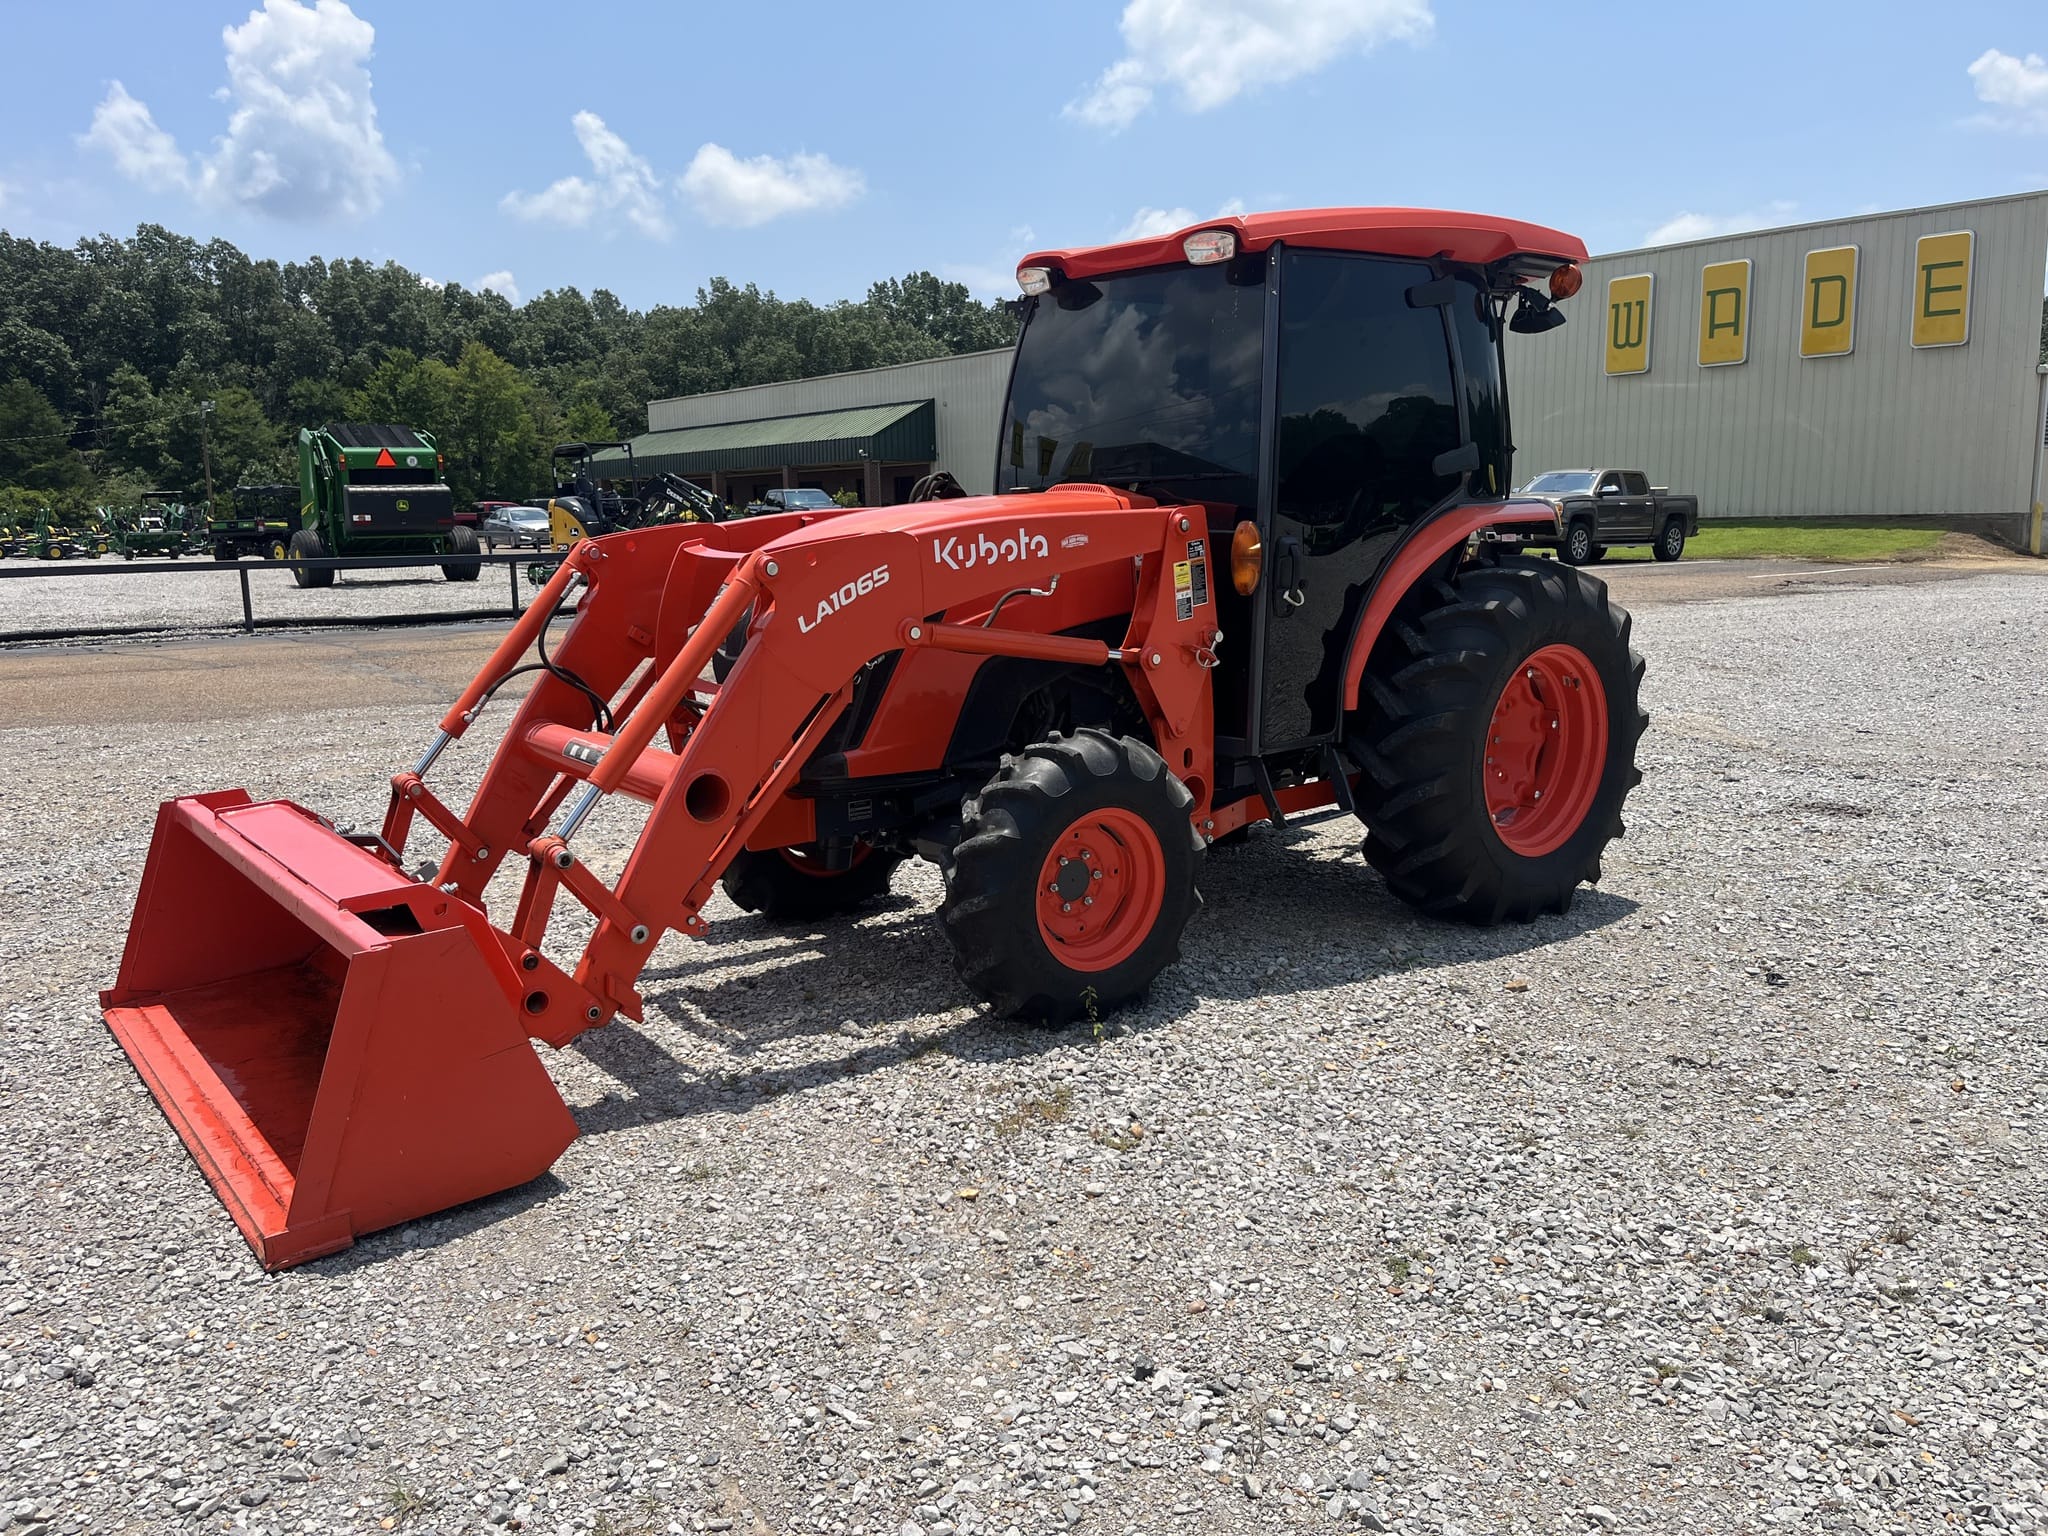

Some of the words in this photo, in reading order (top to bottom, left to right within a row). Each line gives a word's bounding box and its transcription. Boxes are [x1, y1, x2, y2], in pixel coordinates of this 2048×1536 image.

[1611, 260, 1964, 349] WADE
[666, 487, 684, 503] DEERE
[933, 527, 1049, 570] Kubota
[797, 564, 890, 634] LA1065
